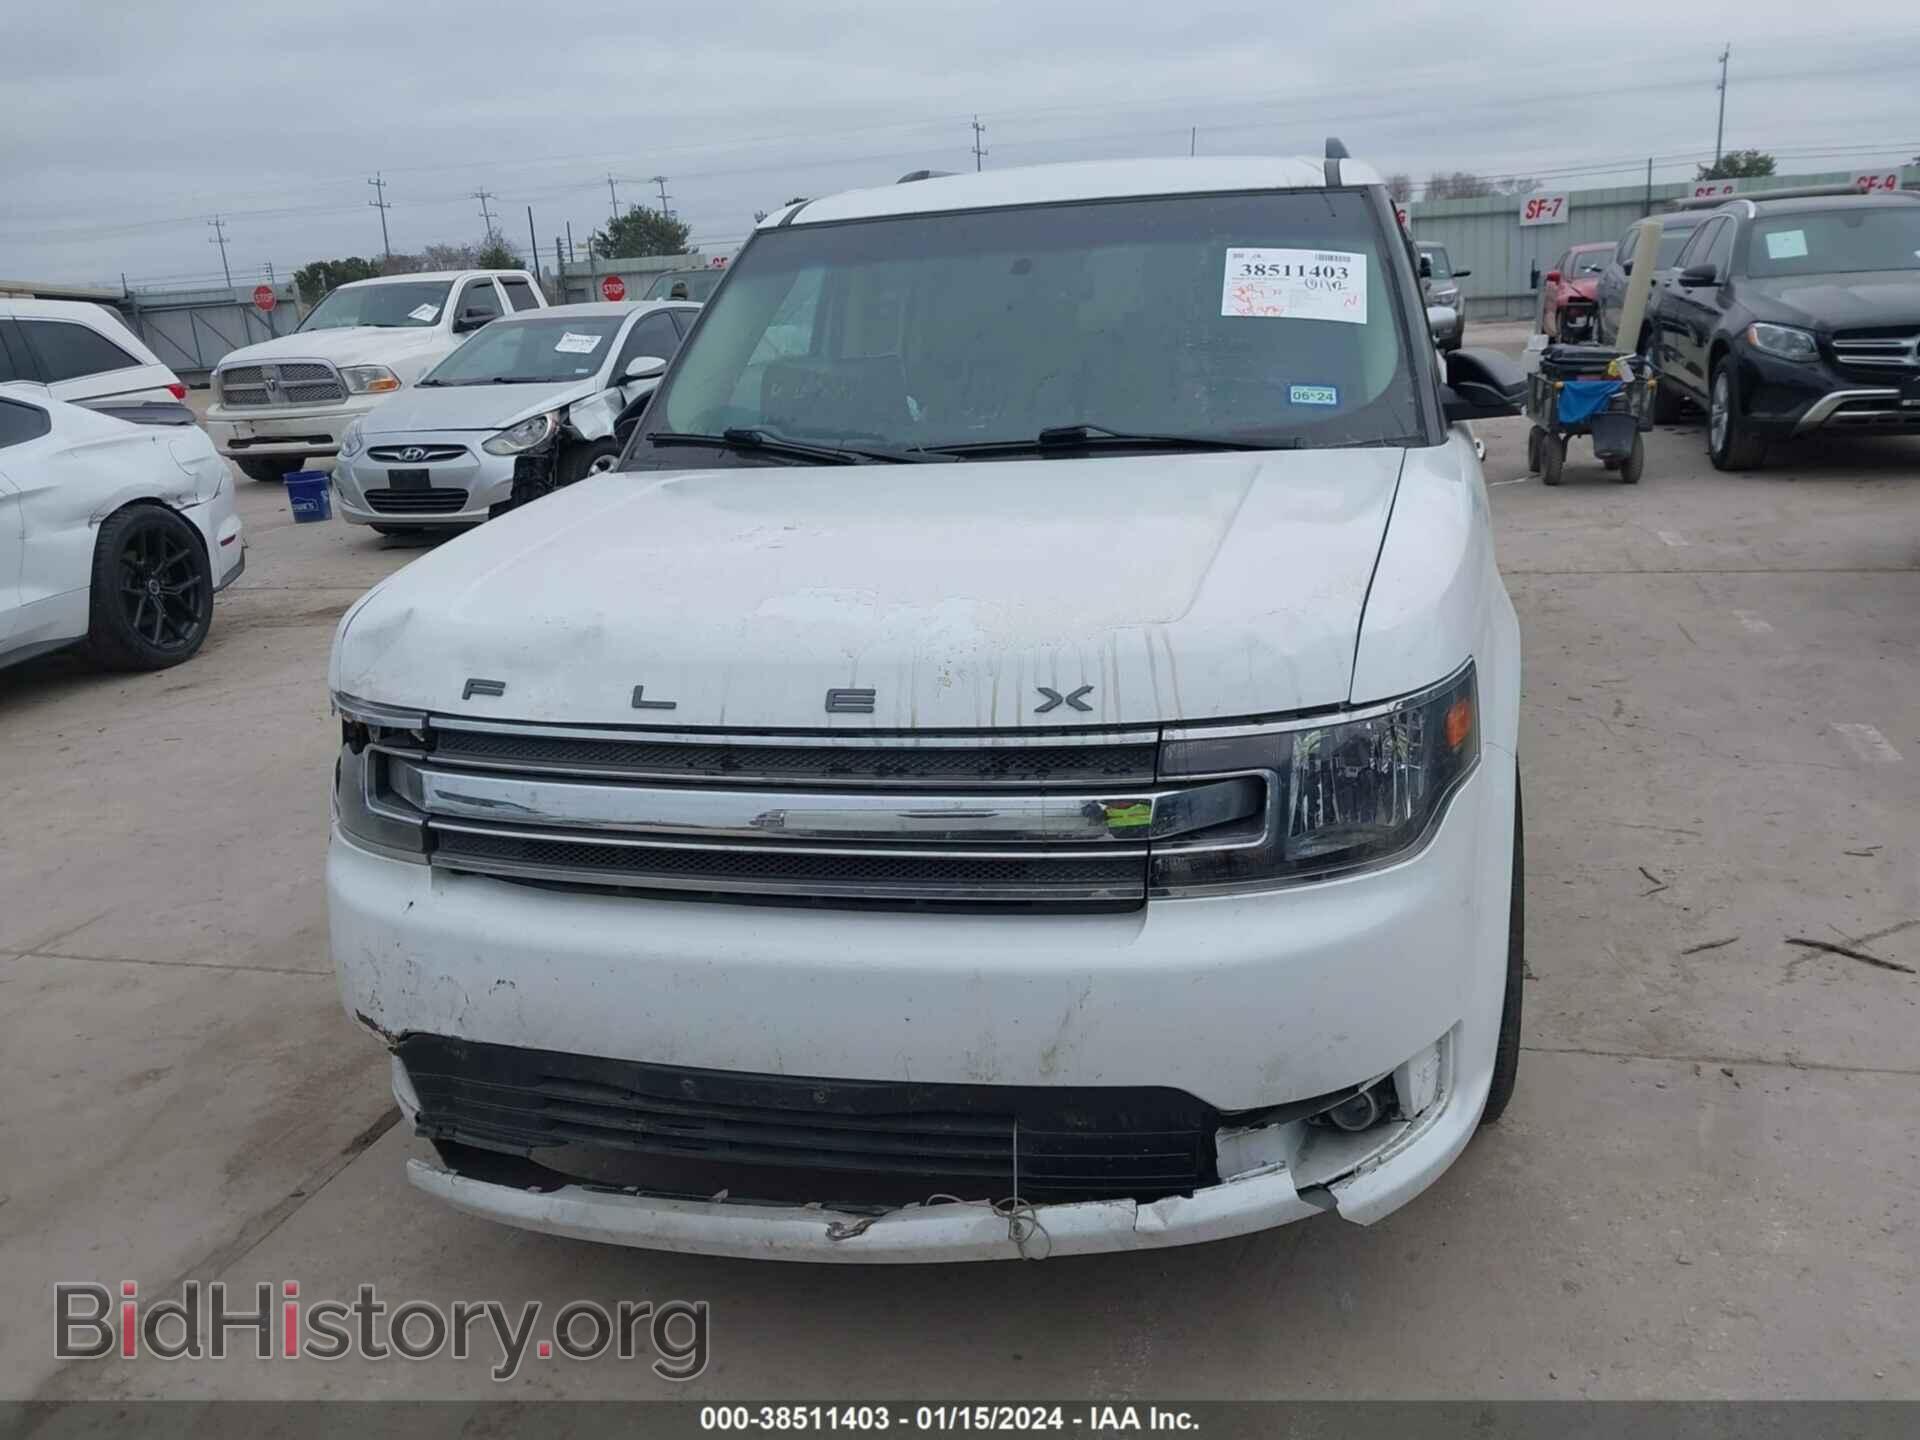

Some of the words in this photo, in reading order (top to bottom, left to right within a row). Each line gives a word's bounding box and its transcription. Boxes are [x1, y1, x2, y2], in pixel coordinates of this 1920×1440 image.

[1526, 197, 1563, 220] SF-7
[1240, 263, 1349, 280] 38511403
[603, 283, 623, 295] STOP
